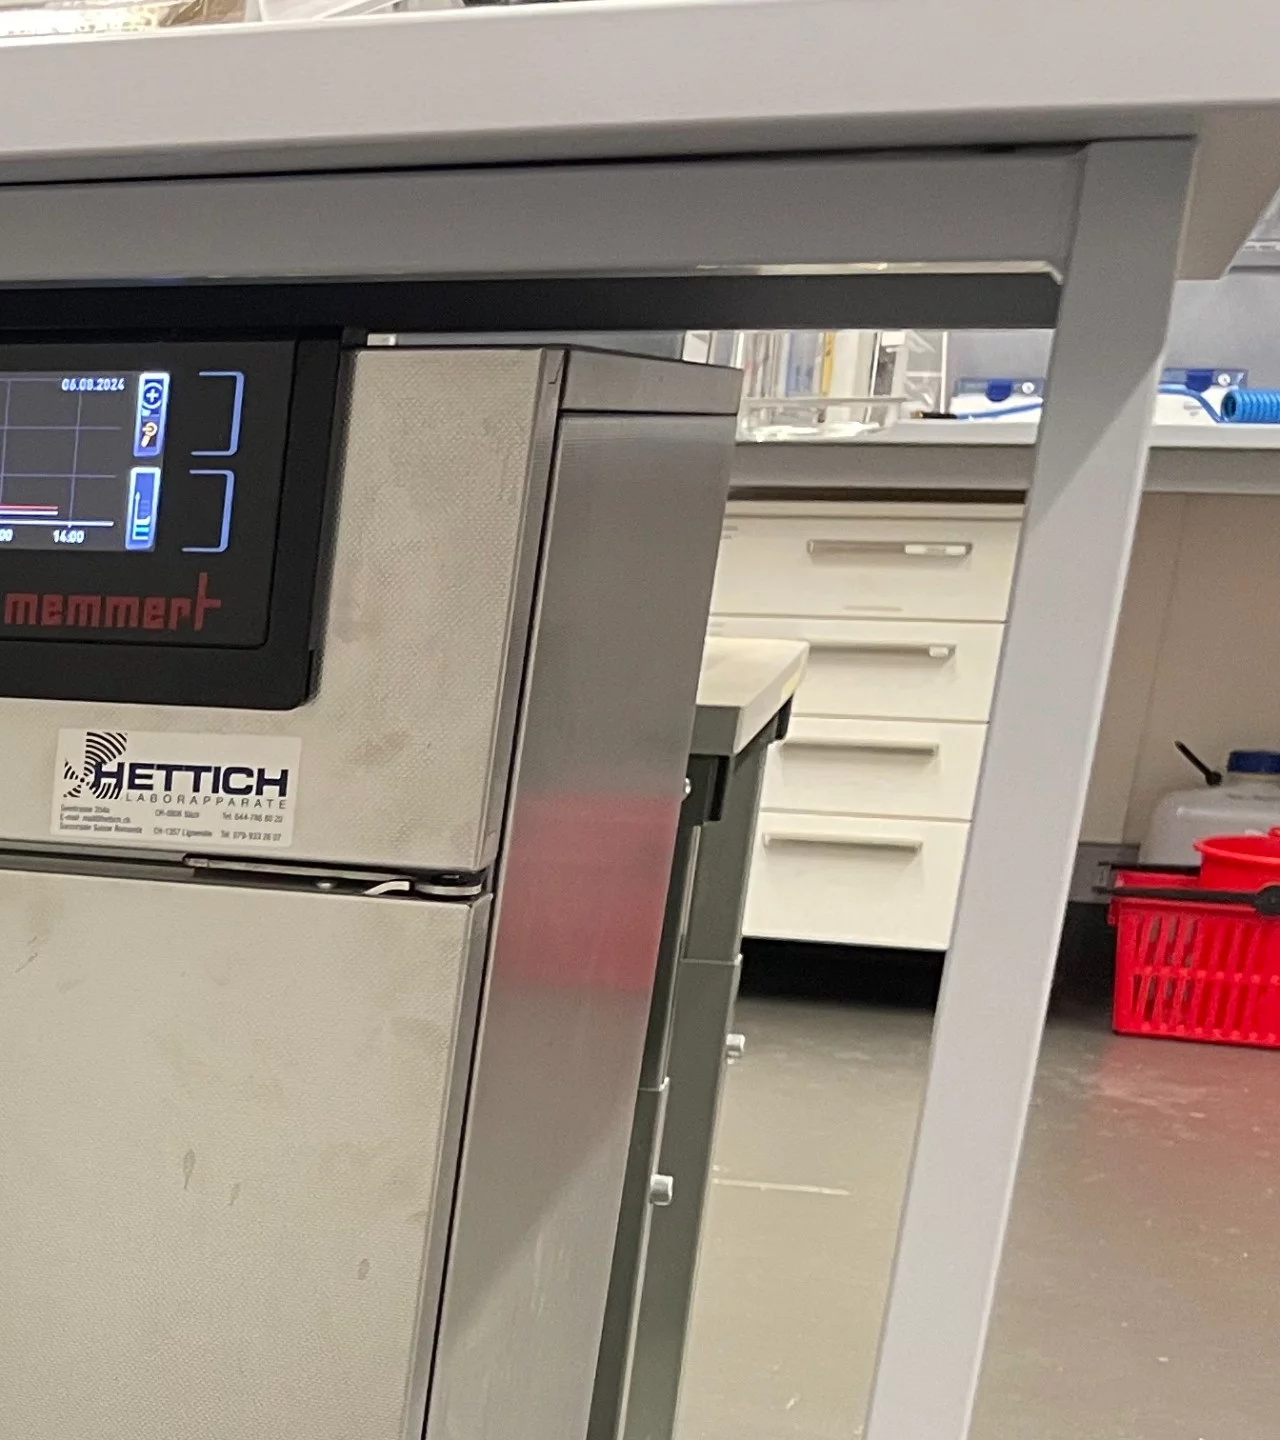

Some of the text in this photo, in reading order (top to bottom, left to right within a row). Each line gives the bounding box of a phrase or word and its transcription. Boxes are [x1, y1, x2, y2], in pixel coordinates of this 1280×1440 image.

[61, 378, 125, 391] 06.08.2024
[53, 530, 85, 544] 14:00
[4, 571, 222, 632] memmert
[93, 761, 290, 798] HETTICH
[125, 792, 288, 810] LABORAPPARATE
